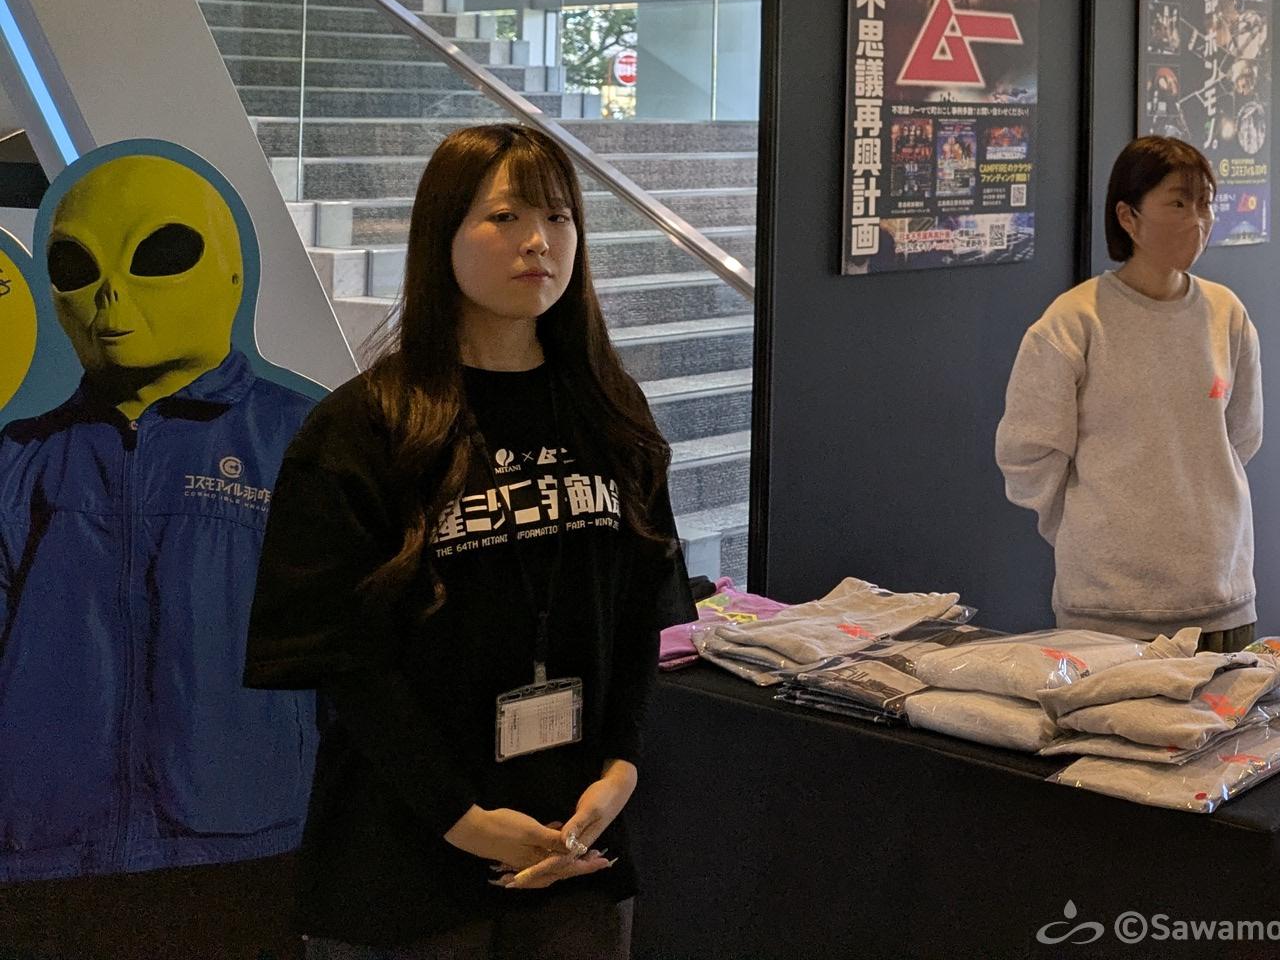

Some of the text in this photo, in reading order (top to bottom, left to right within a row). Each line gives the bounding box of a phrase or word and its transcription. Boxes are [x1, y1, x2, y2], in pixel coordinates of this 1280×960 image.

[494, 465, 522, 474] MITANI
[184, 475, 272, 503] コスモアイル羽咋
[435, 546, 454, 558] THE
[456, 540, 479, 552] 64TH
[482, 534, 508, 547] MITANI
[566, 520, 586, 531] FAIR
